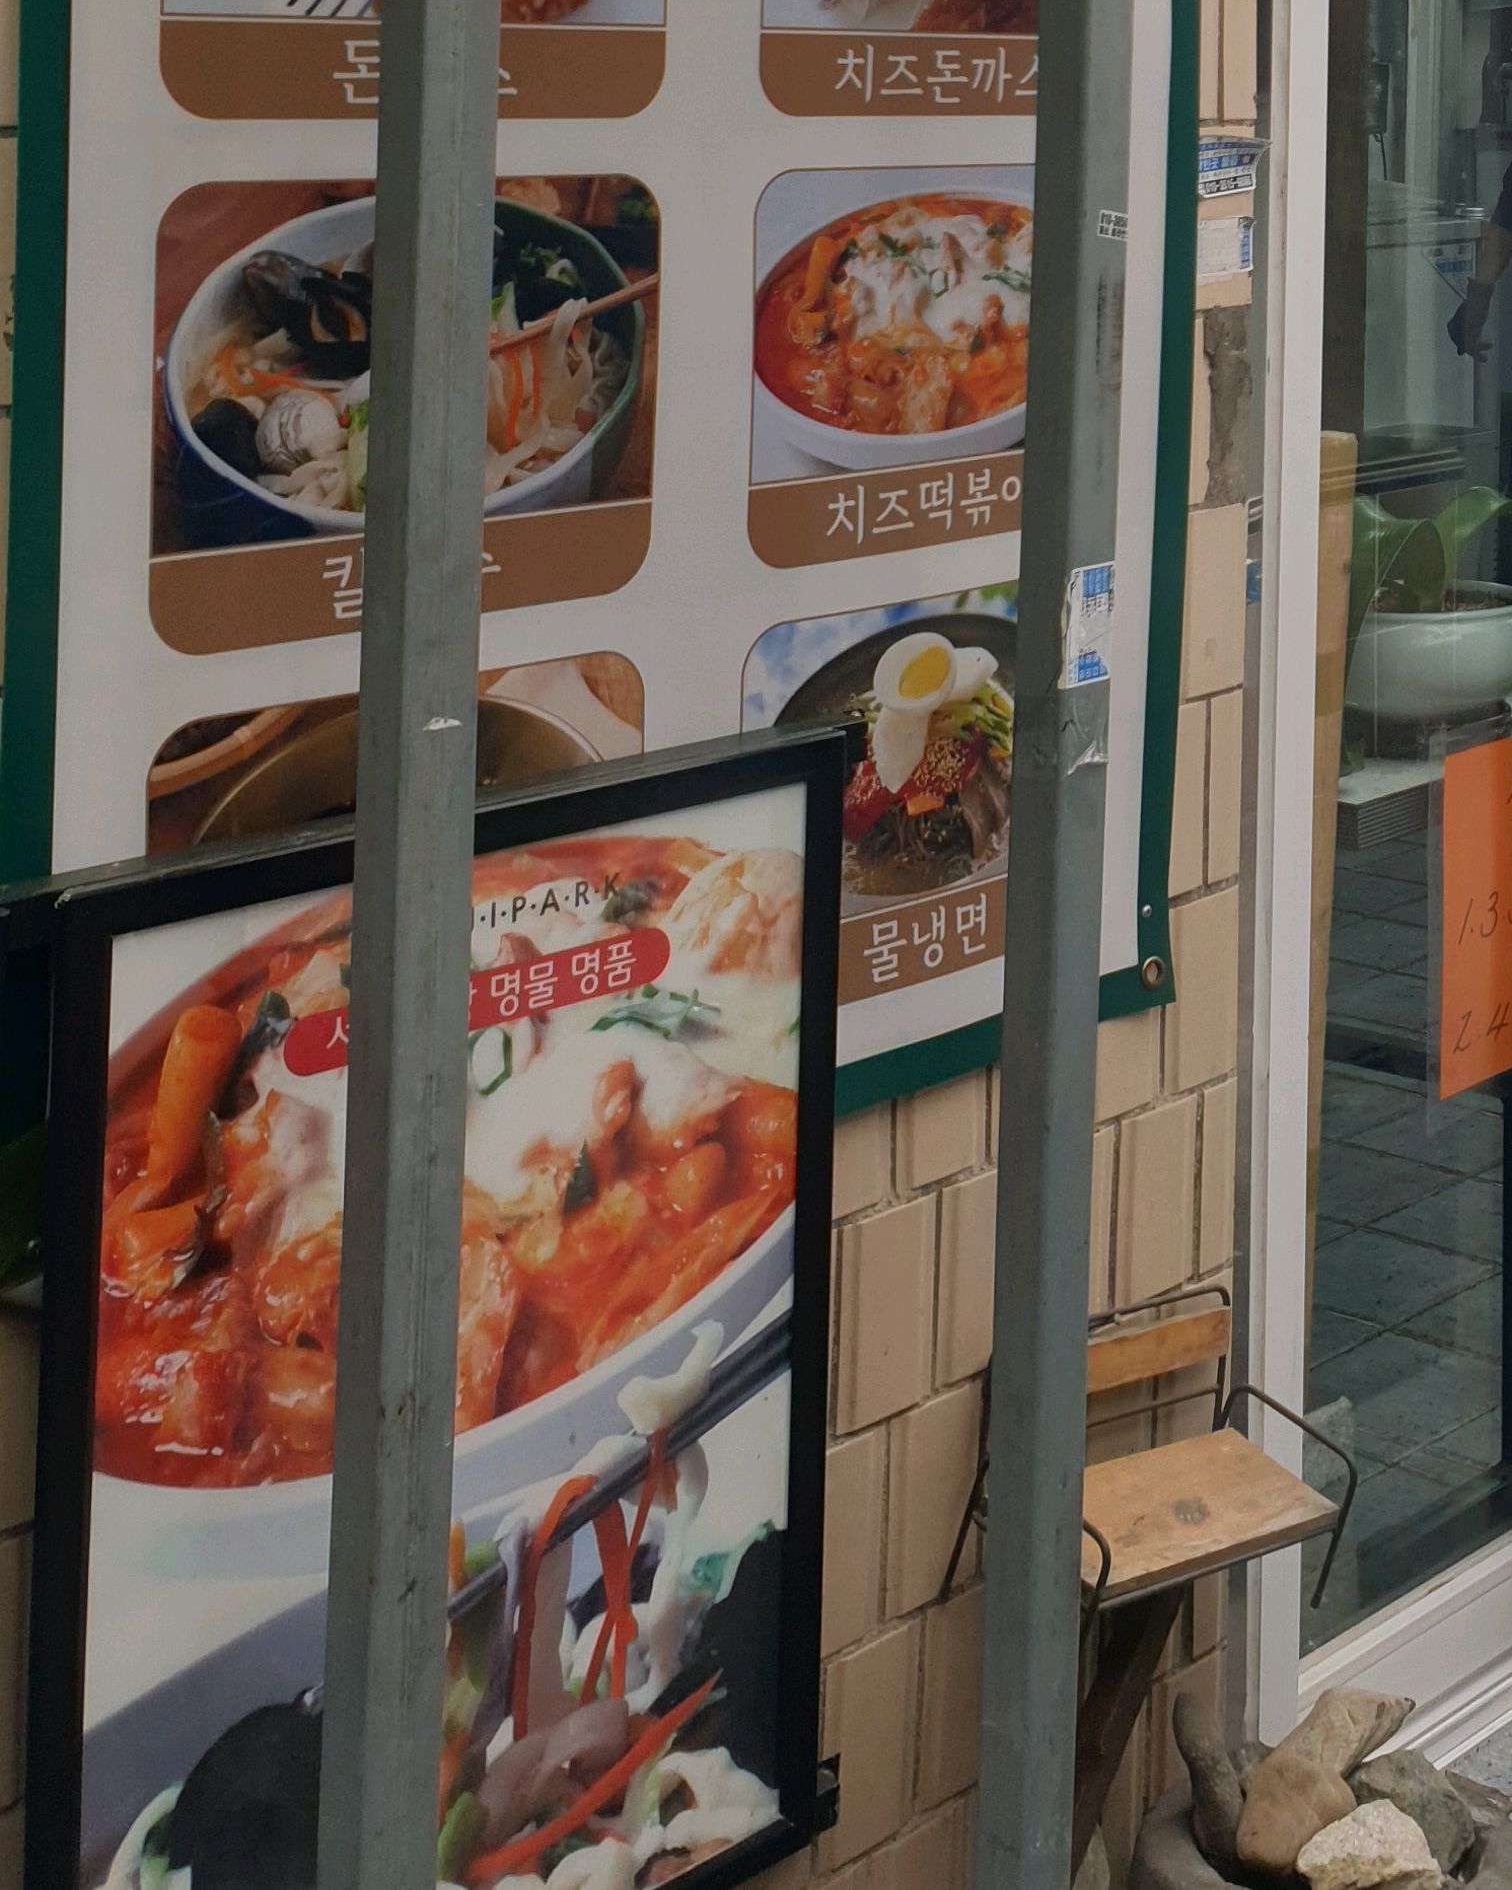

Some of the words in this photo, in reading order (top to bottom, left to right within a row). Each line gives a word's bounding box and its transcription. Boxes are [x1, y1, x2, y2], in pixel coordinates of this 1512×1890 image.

[489, 960, 559, 1017] 명물
[571, 939, 638, 995] 명품
[863, 892, 988, 984] 물냉면
